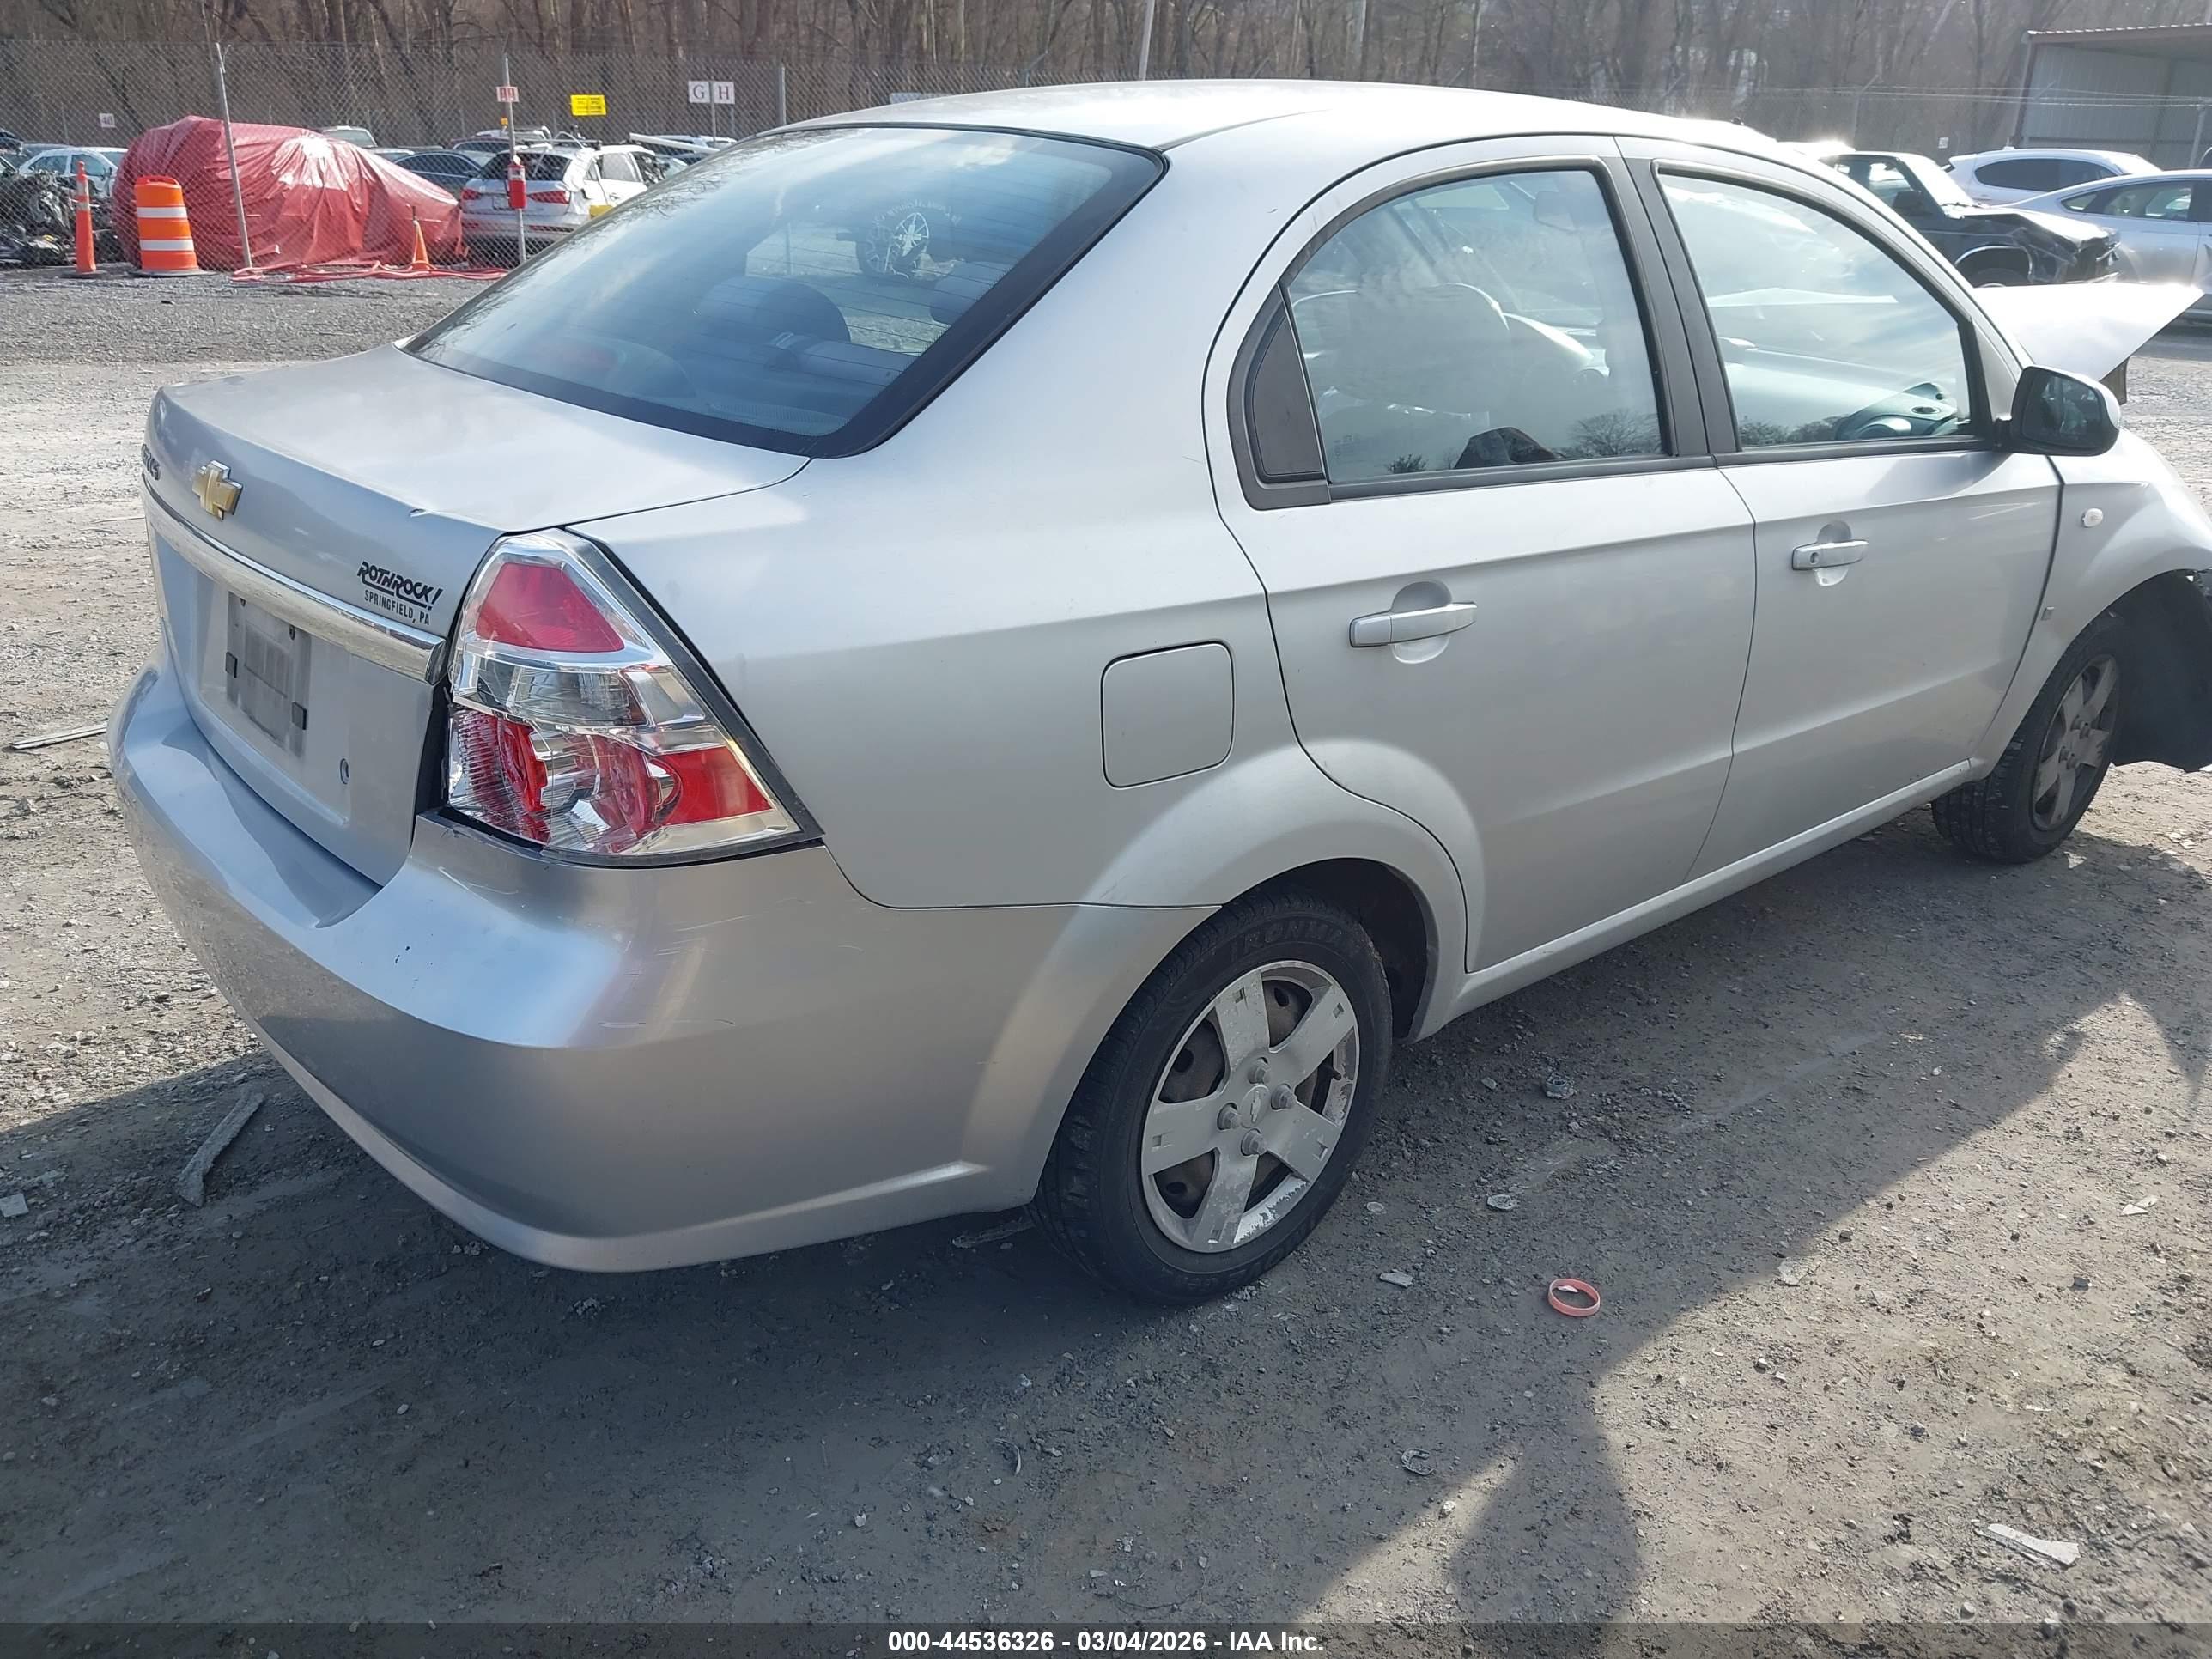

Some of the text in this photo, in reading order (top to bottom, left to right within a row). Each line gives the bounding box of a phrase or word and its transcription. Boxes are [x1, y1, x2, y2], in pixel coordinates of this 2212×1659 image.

[693, 84, 704, 100] G
[718, 85, 729, 100] H
[356, 560, 444, 611] ROTHROCK!
[364, 589, 430, 625] SPRINGFIELD, PA
